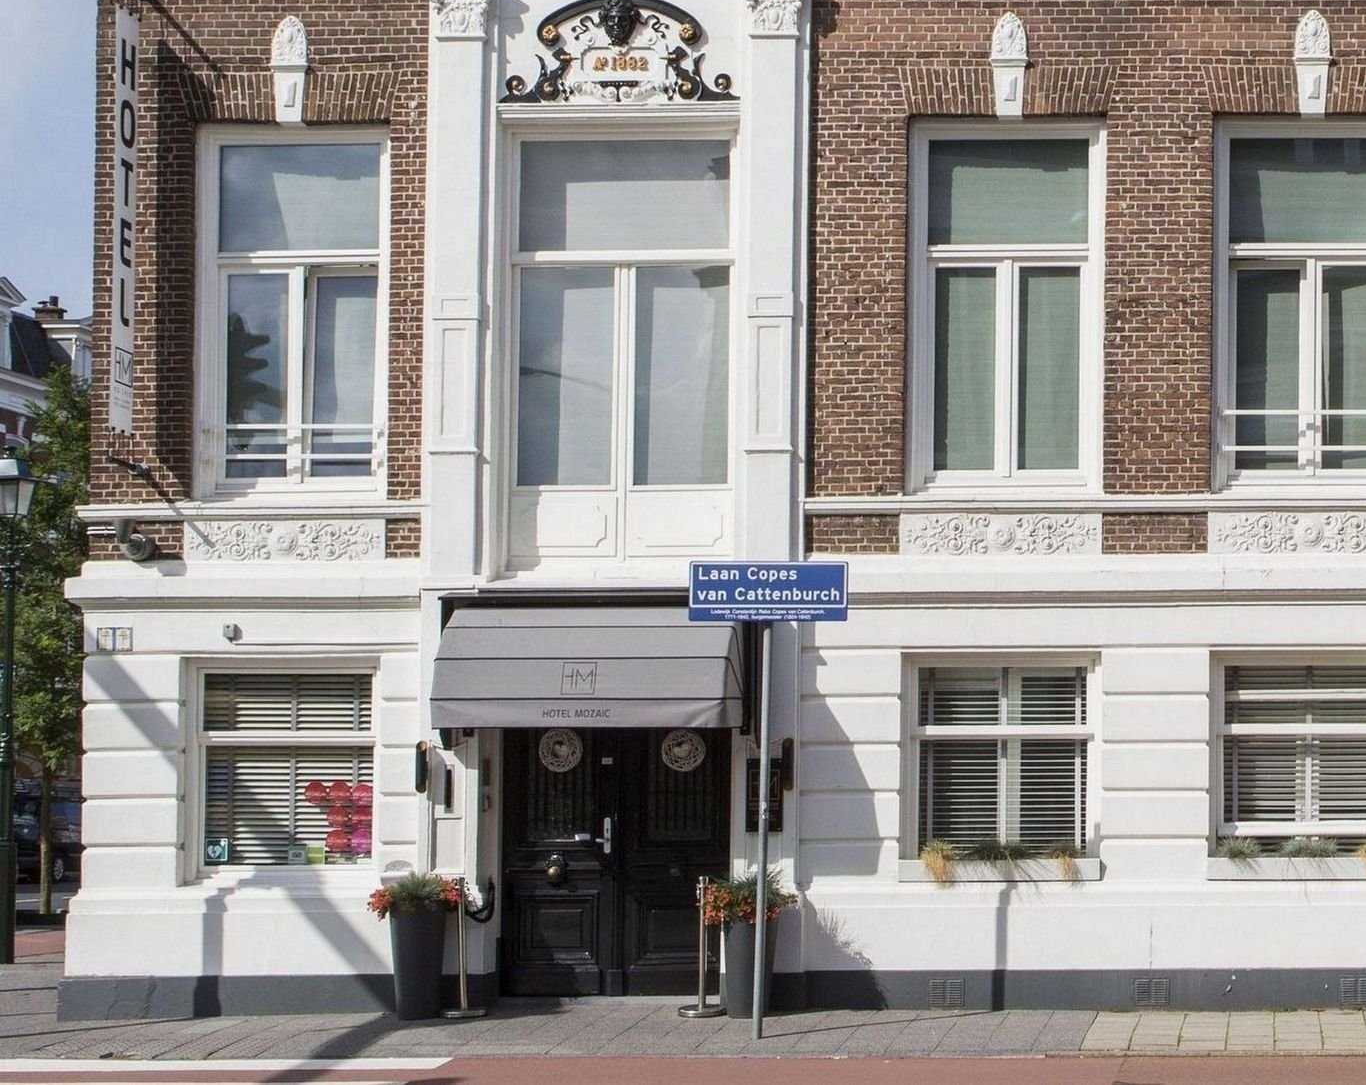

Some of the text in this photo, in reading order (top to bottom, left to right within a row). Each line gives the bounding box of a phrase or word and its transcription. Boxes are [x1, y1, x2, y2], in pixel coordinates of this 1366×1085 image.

[120, 37, 136, 327] HOTEL
[698, 567, 798, 583] Laan Copes
[697, 587, 840, 601] van Cattenburch
[542, 709, 611, 718] HOTEL MOZAIC
